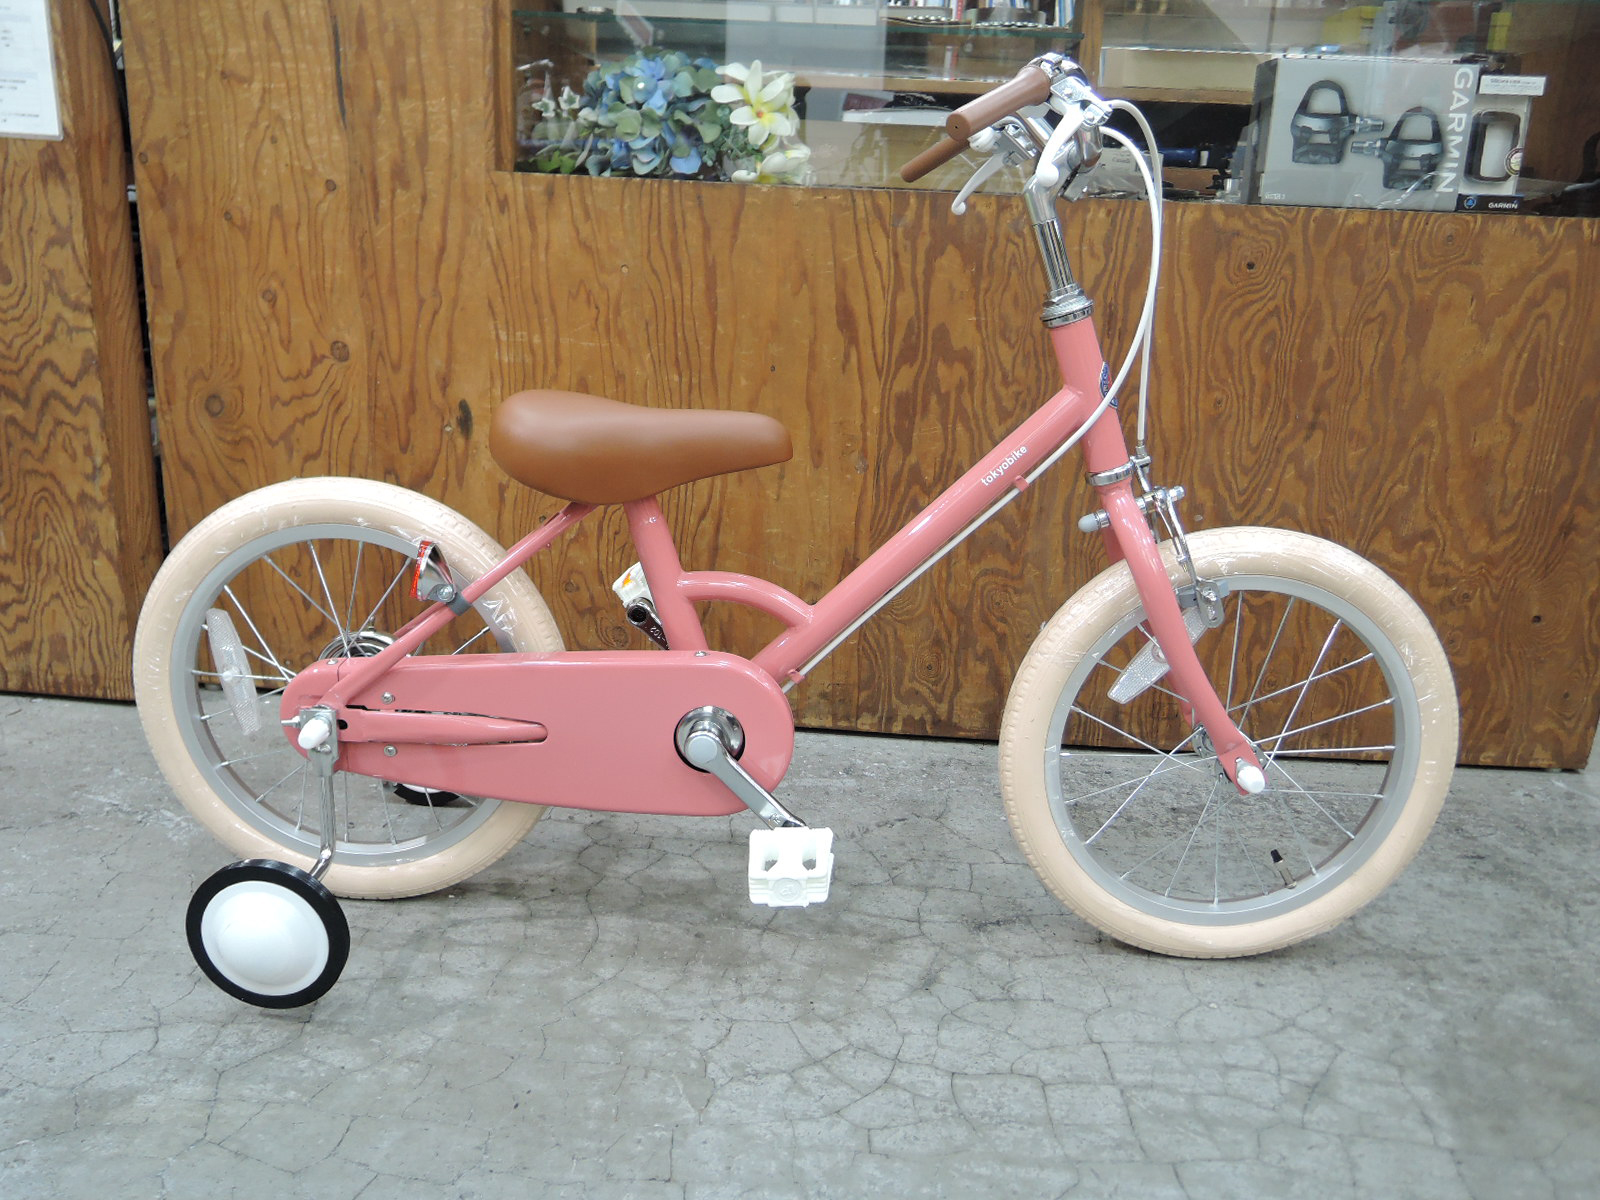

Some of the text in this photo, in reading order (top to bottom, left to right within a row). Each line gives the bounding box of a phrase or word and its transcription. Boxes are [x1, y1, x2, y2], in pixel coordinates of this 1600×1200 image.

[1435, 67, 1474, 194] GARMIN
[1488, 201, 1519, 210] GARMIN
[980, 446, 1027, 486] tokyobike
